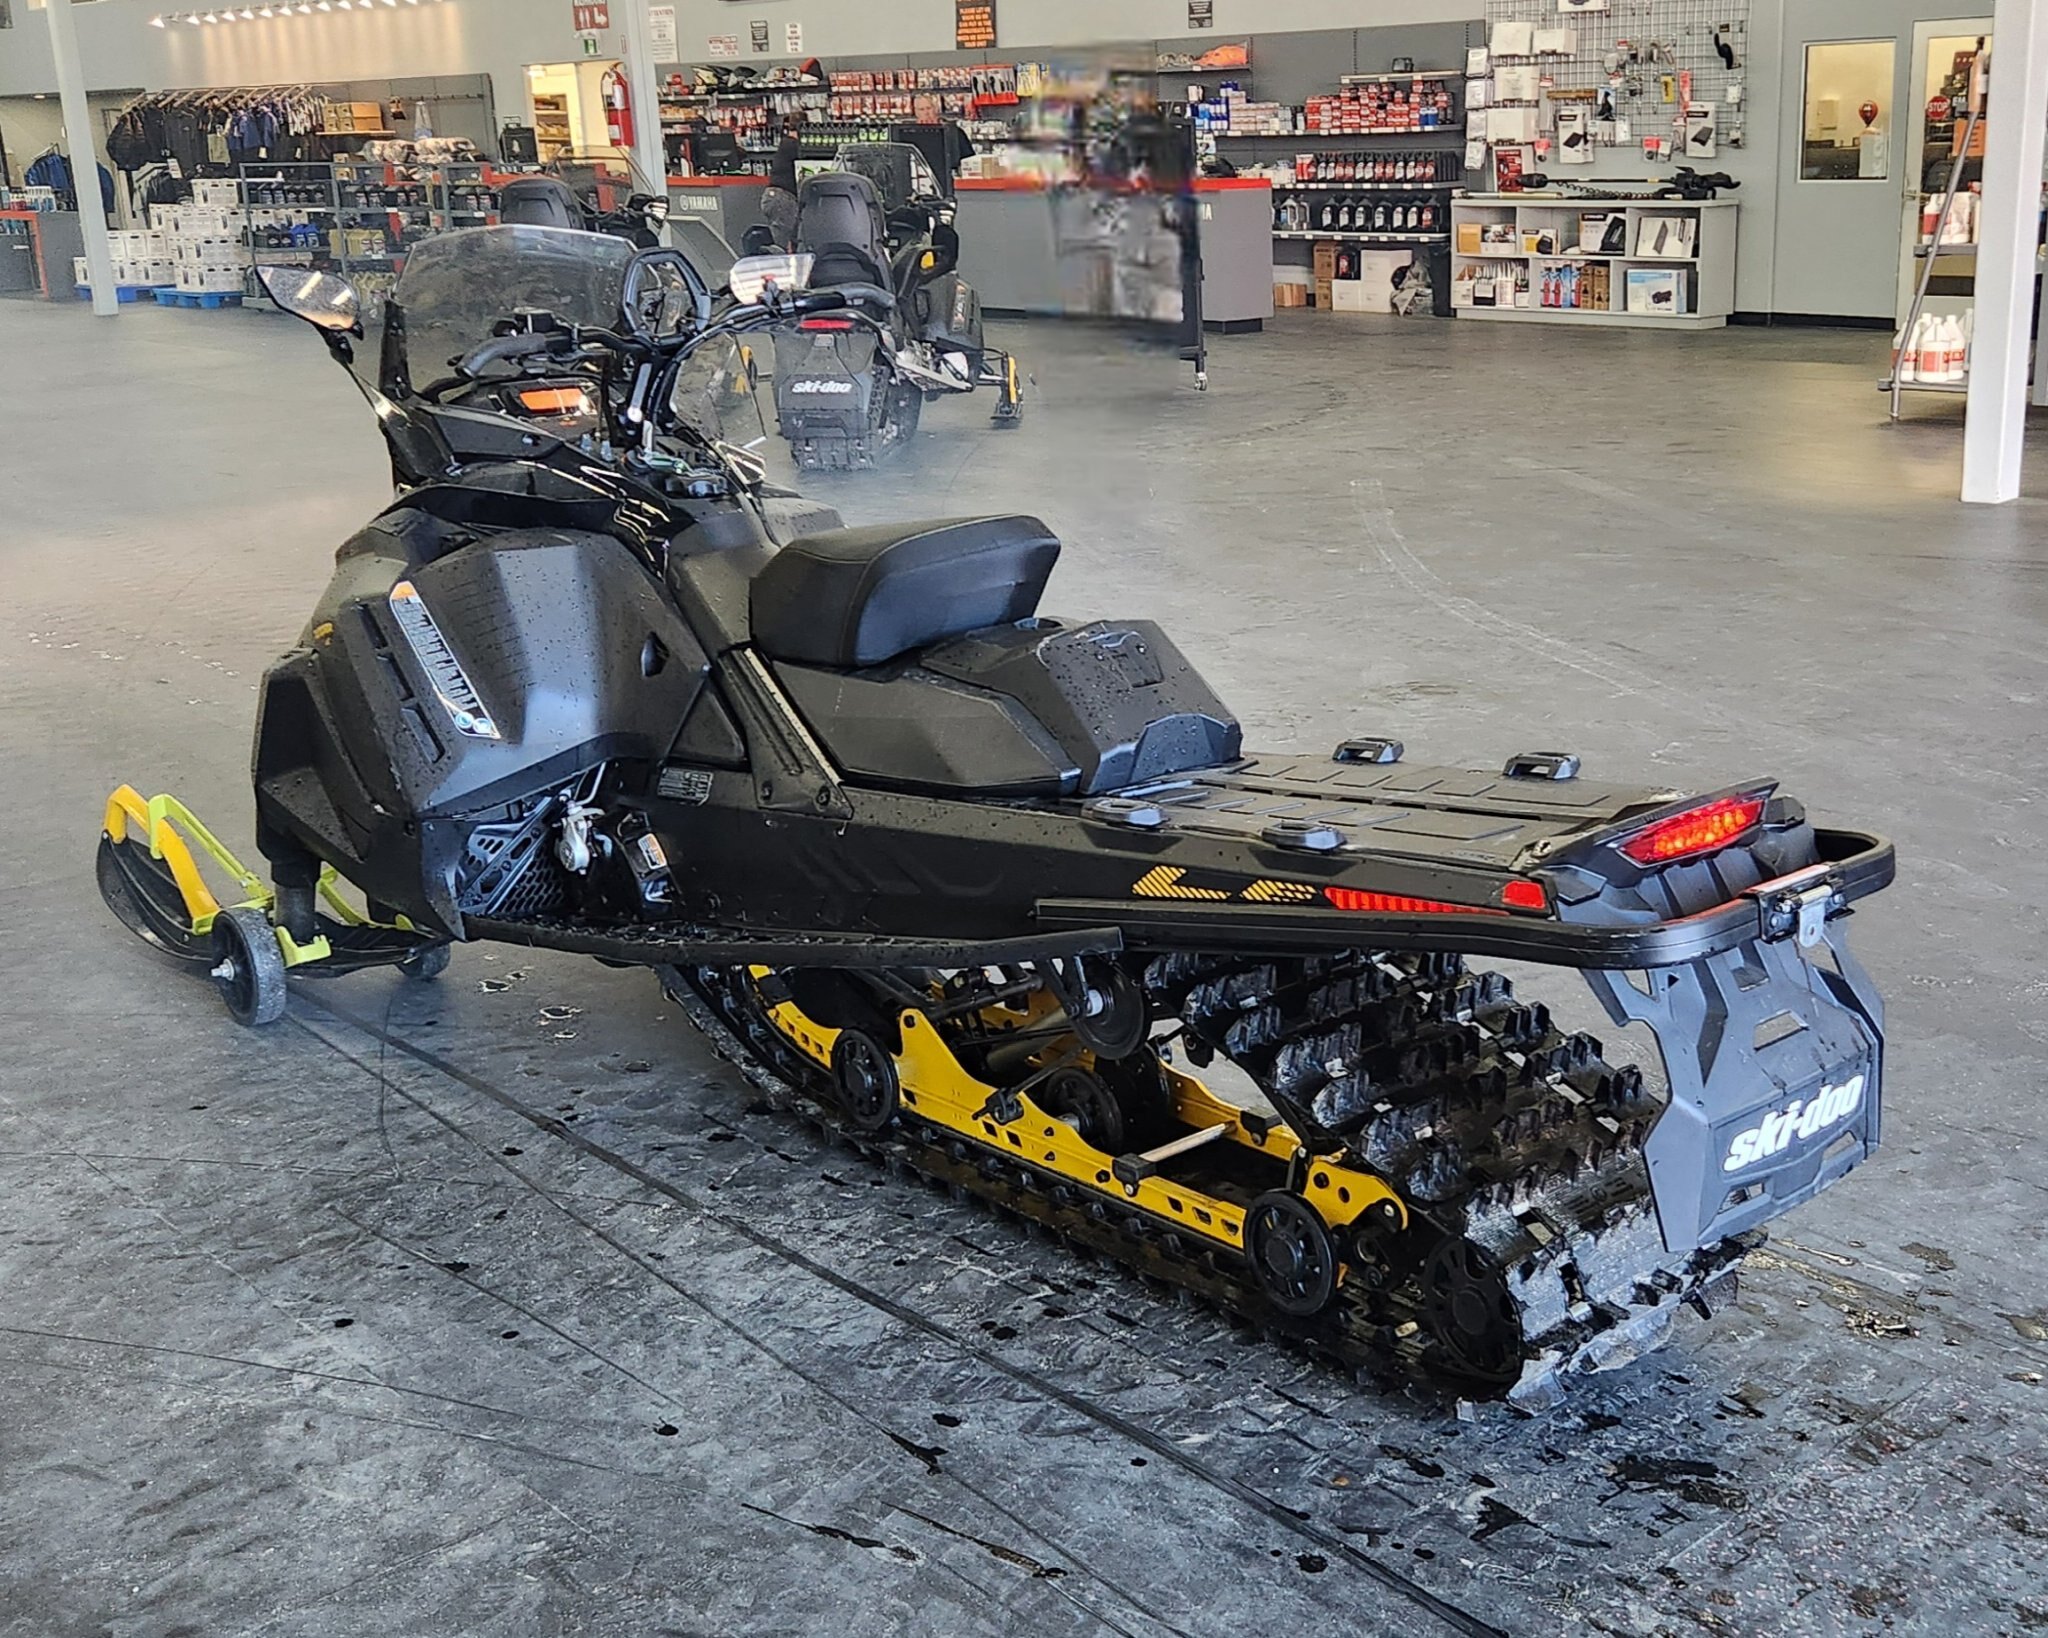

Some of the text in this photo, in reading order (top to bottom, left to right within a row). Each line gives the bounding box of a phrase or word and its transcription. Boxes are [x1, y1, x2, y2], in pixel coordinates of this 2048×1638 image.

[1928, 102, 1948, 112] STOP
[688, 196, 718, 210] YAMAHA
[792, 380, 852, 393] ski-doo
[1722, 1074, 1866, 1172] ski-doo
